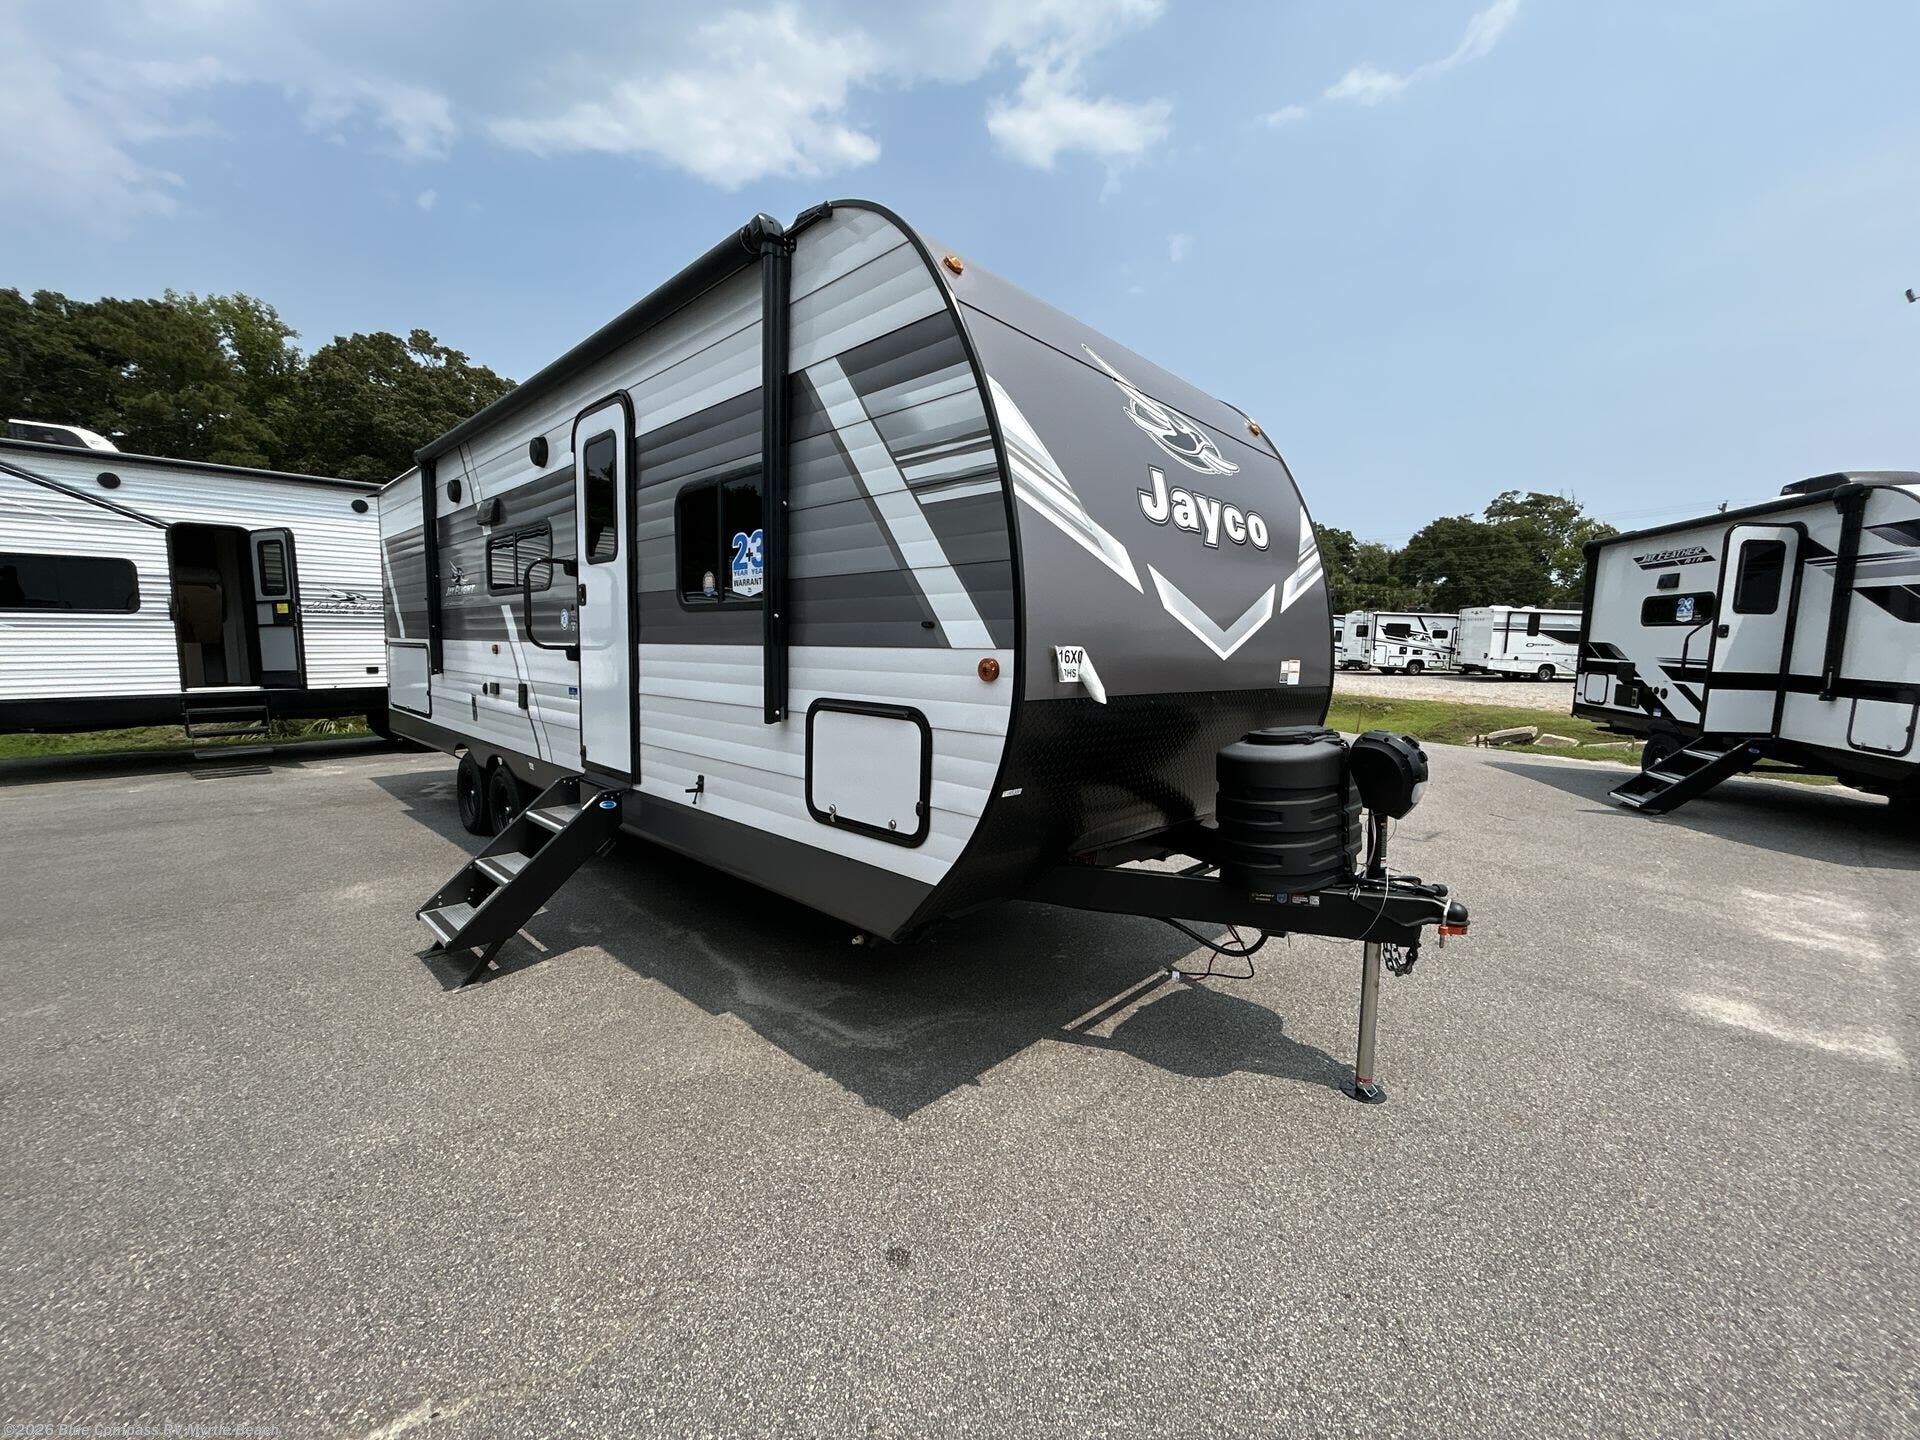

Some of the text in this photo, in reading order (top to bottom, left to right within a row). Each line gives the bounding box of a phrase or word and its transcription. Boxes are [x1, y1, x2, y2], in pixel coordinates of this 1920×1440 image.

[1137, 464, 1270, 551] Jayco
[1657, 546, 1702, 561] FEATHER
[734, 578, 763, 587] WARRANT
